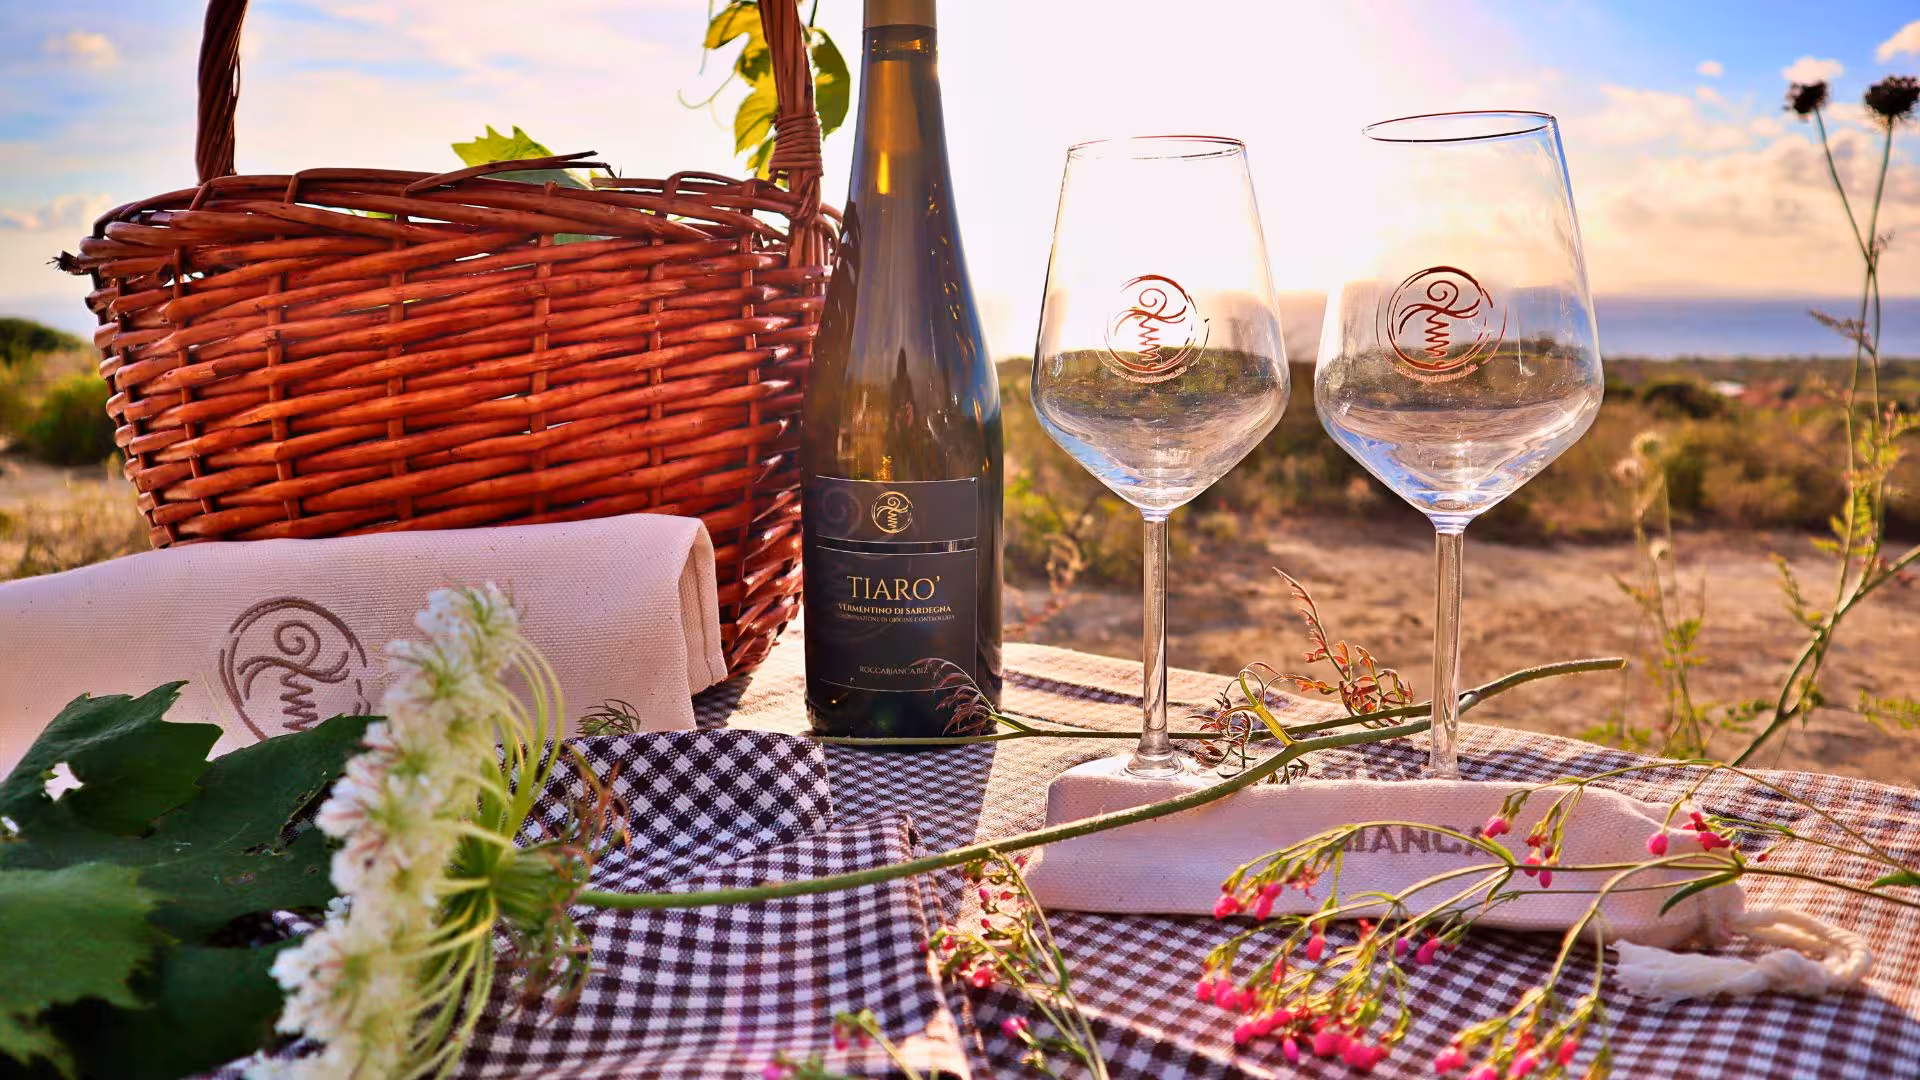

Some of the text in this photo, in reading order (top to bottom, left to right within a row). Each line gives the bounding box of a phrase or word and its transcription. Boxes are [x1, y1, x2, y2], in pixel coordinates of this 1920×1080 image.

[846, 575, 941, 601] TIARO'
[838, 602, 952, 616] VERMENTINO DI SARDEGNA
